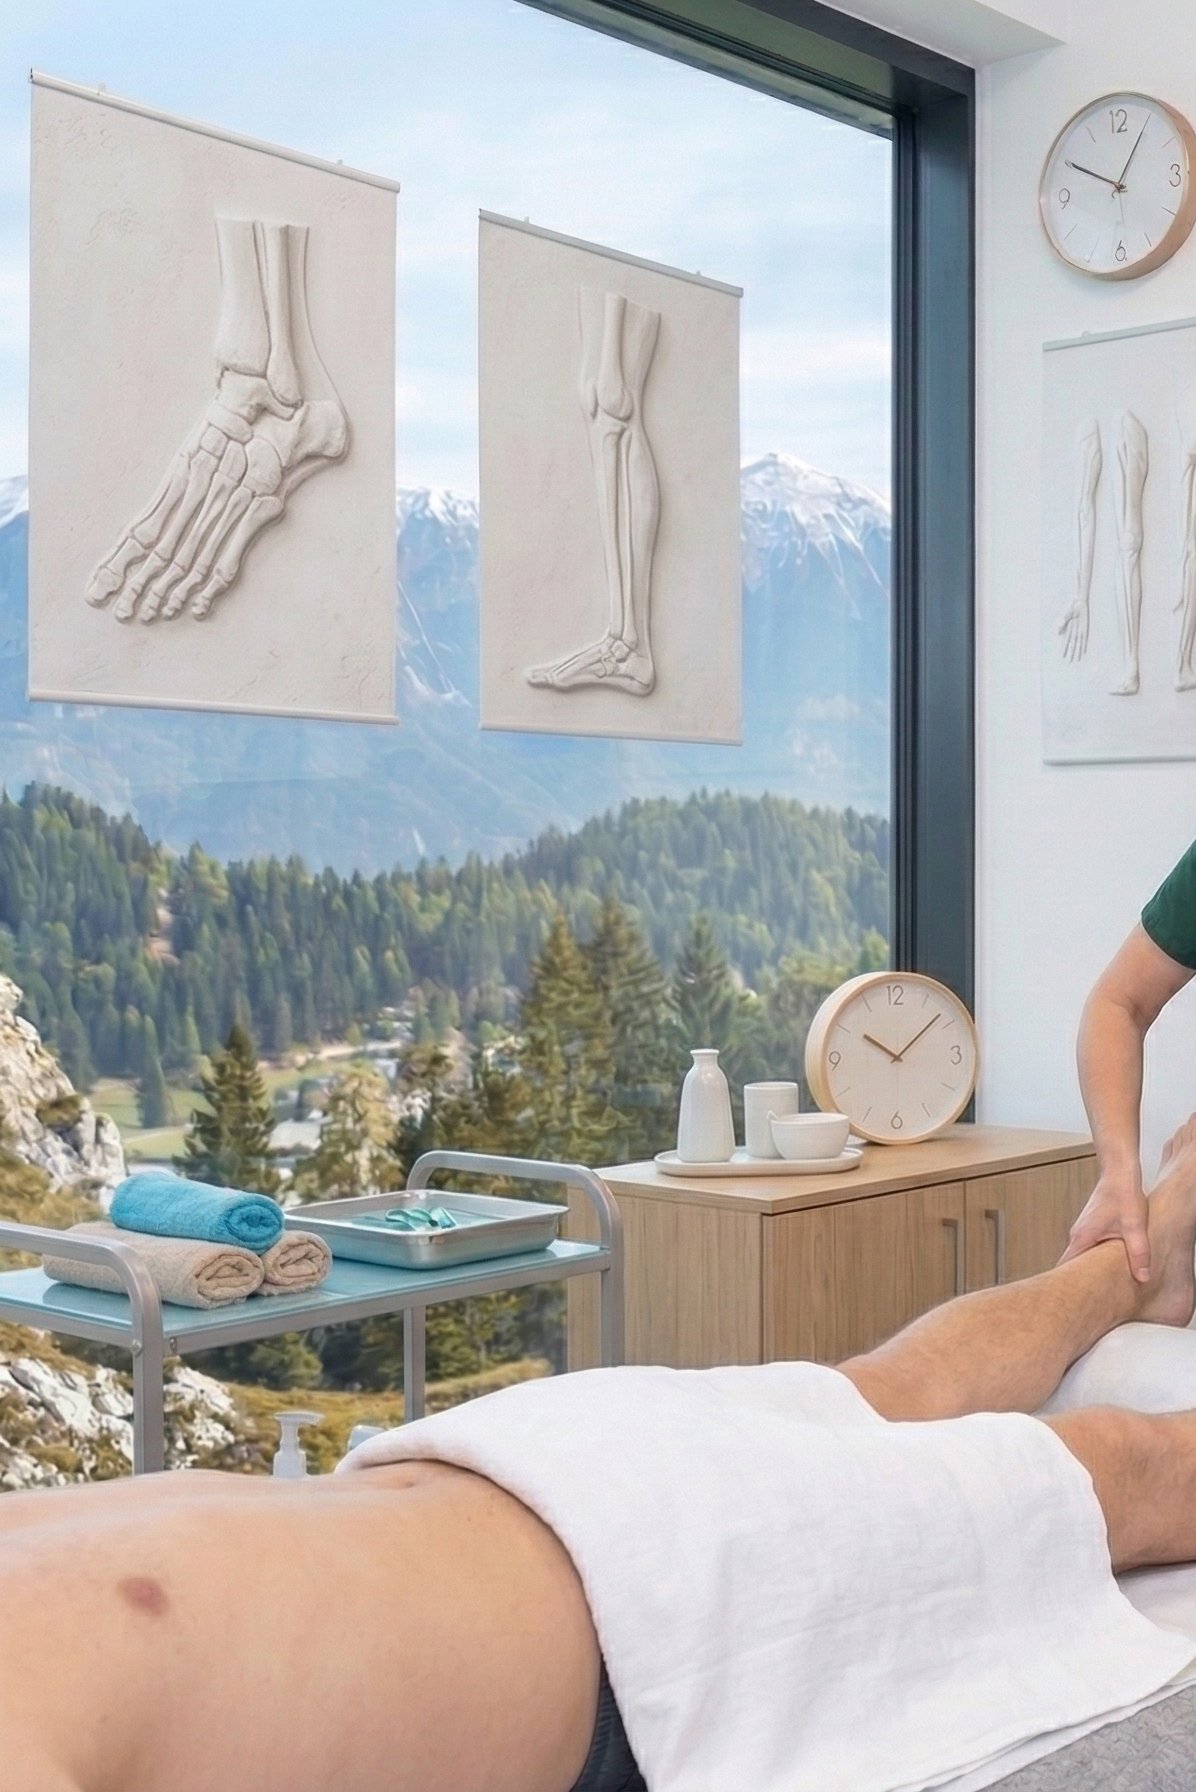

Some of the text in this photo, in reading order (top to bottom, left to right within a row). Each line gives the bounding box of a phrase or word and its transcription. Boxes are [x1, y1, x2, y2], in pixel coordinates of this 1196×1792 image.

[1109, 108, 1128, 134] 12
[1168, 163, 1181, 188] 3
[1058, 187, 1071, 211] 9
[1114, 239, 1127, 262] 6
[885, 984, 904, 1006] 12
[828, 1050, 842, 1071] 9
[950, 1044, 963, 1066] 3
[890, 1109, 903, 1130] 6
